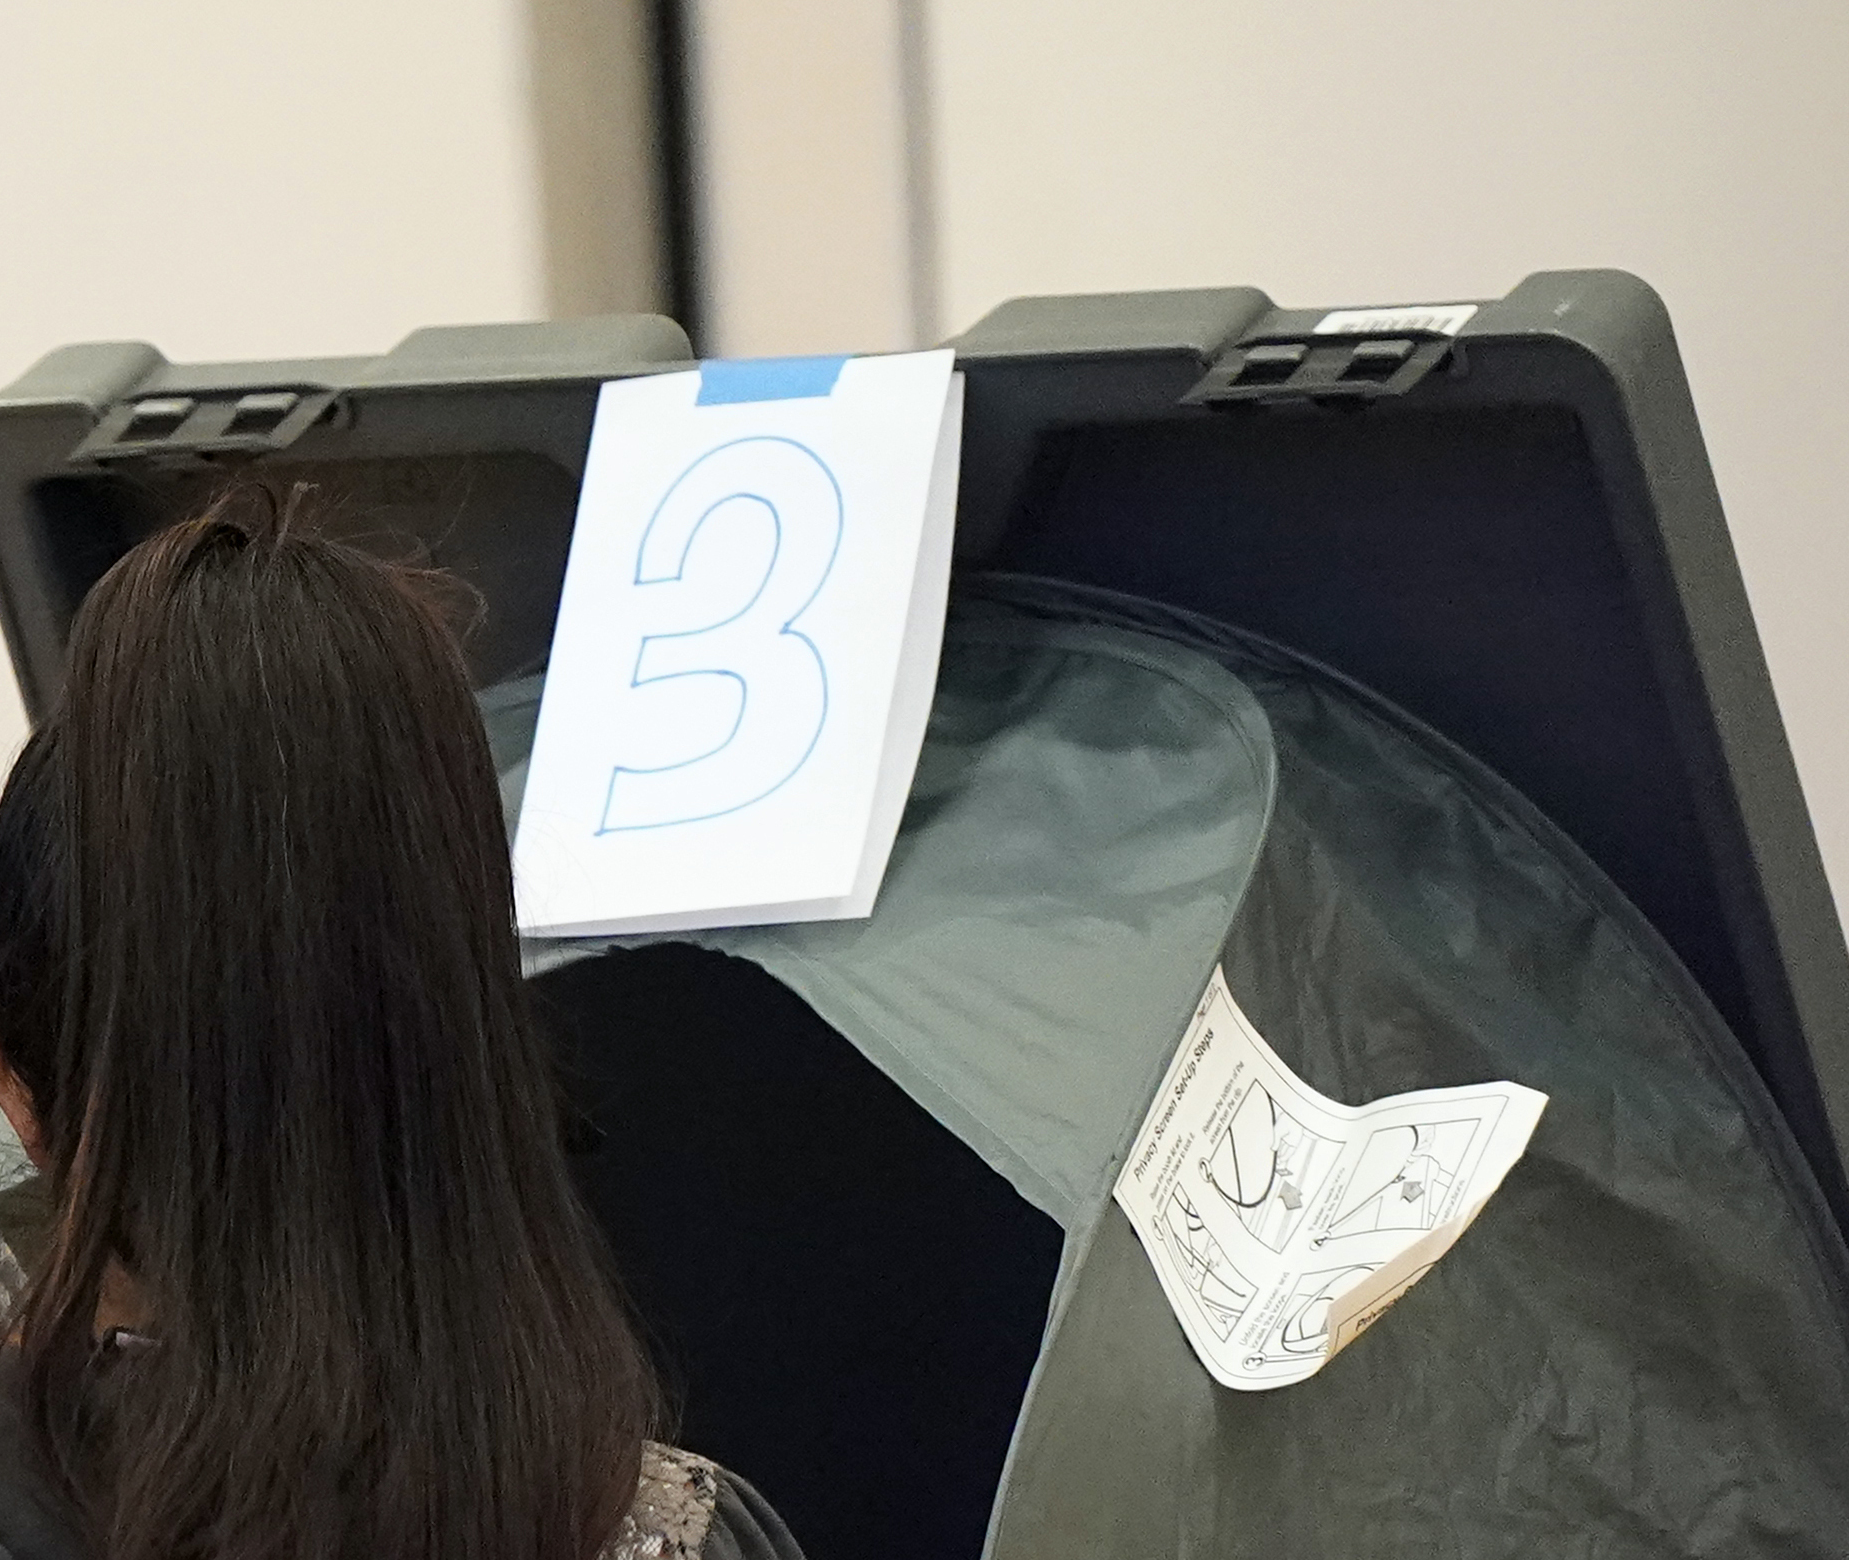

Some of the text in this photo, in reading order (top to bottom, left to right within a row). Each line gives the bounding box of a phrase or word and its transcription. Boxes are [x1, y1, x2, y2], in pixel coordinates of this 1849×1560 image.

[594, 436, 844, 836] 3
[1133, 1028, 1214, 1182] Privacy Screen Set-Up Steps
